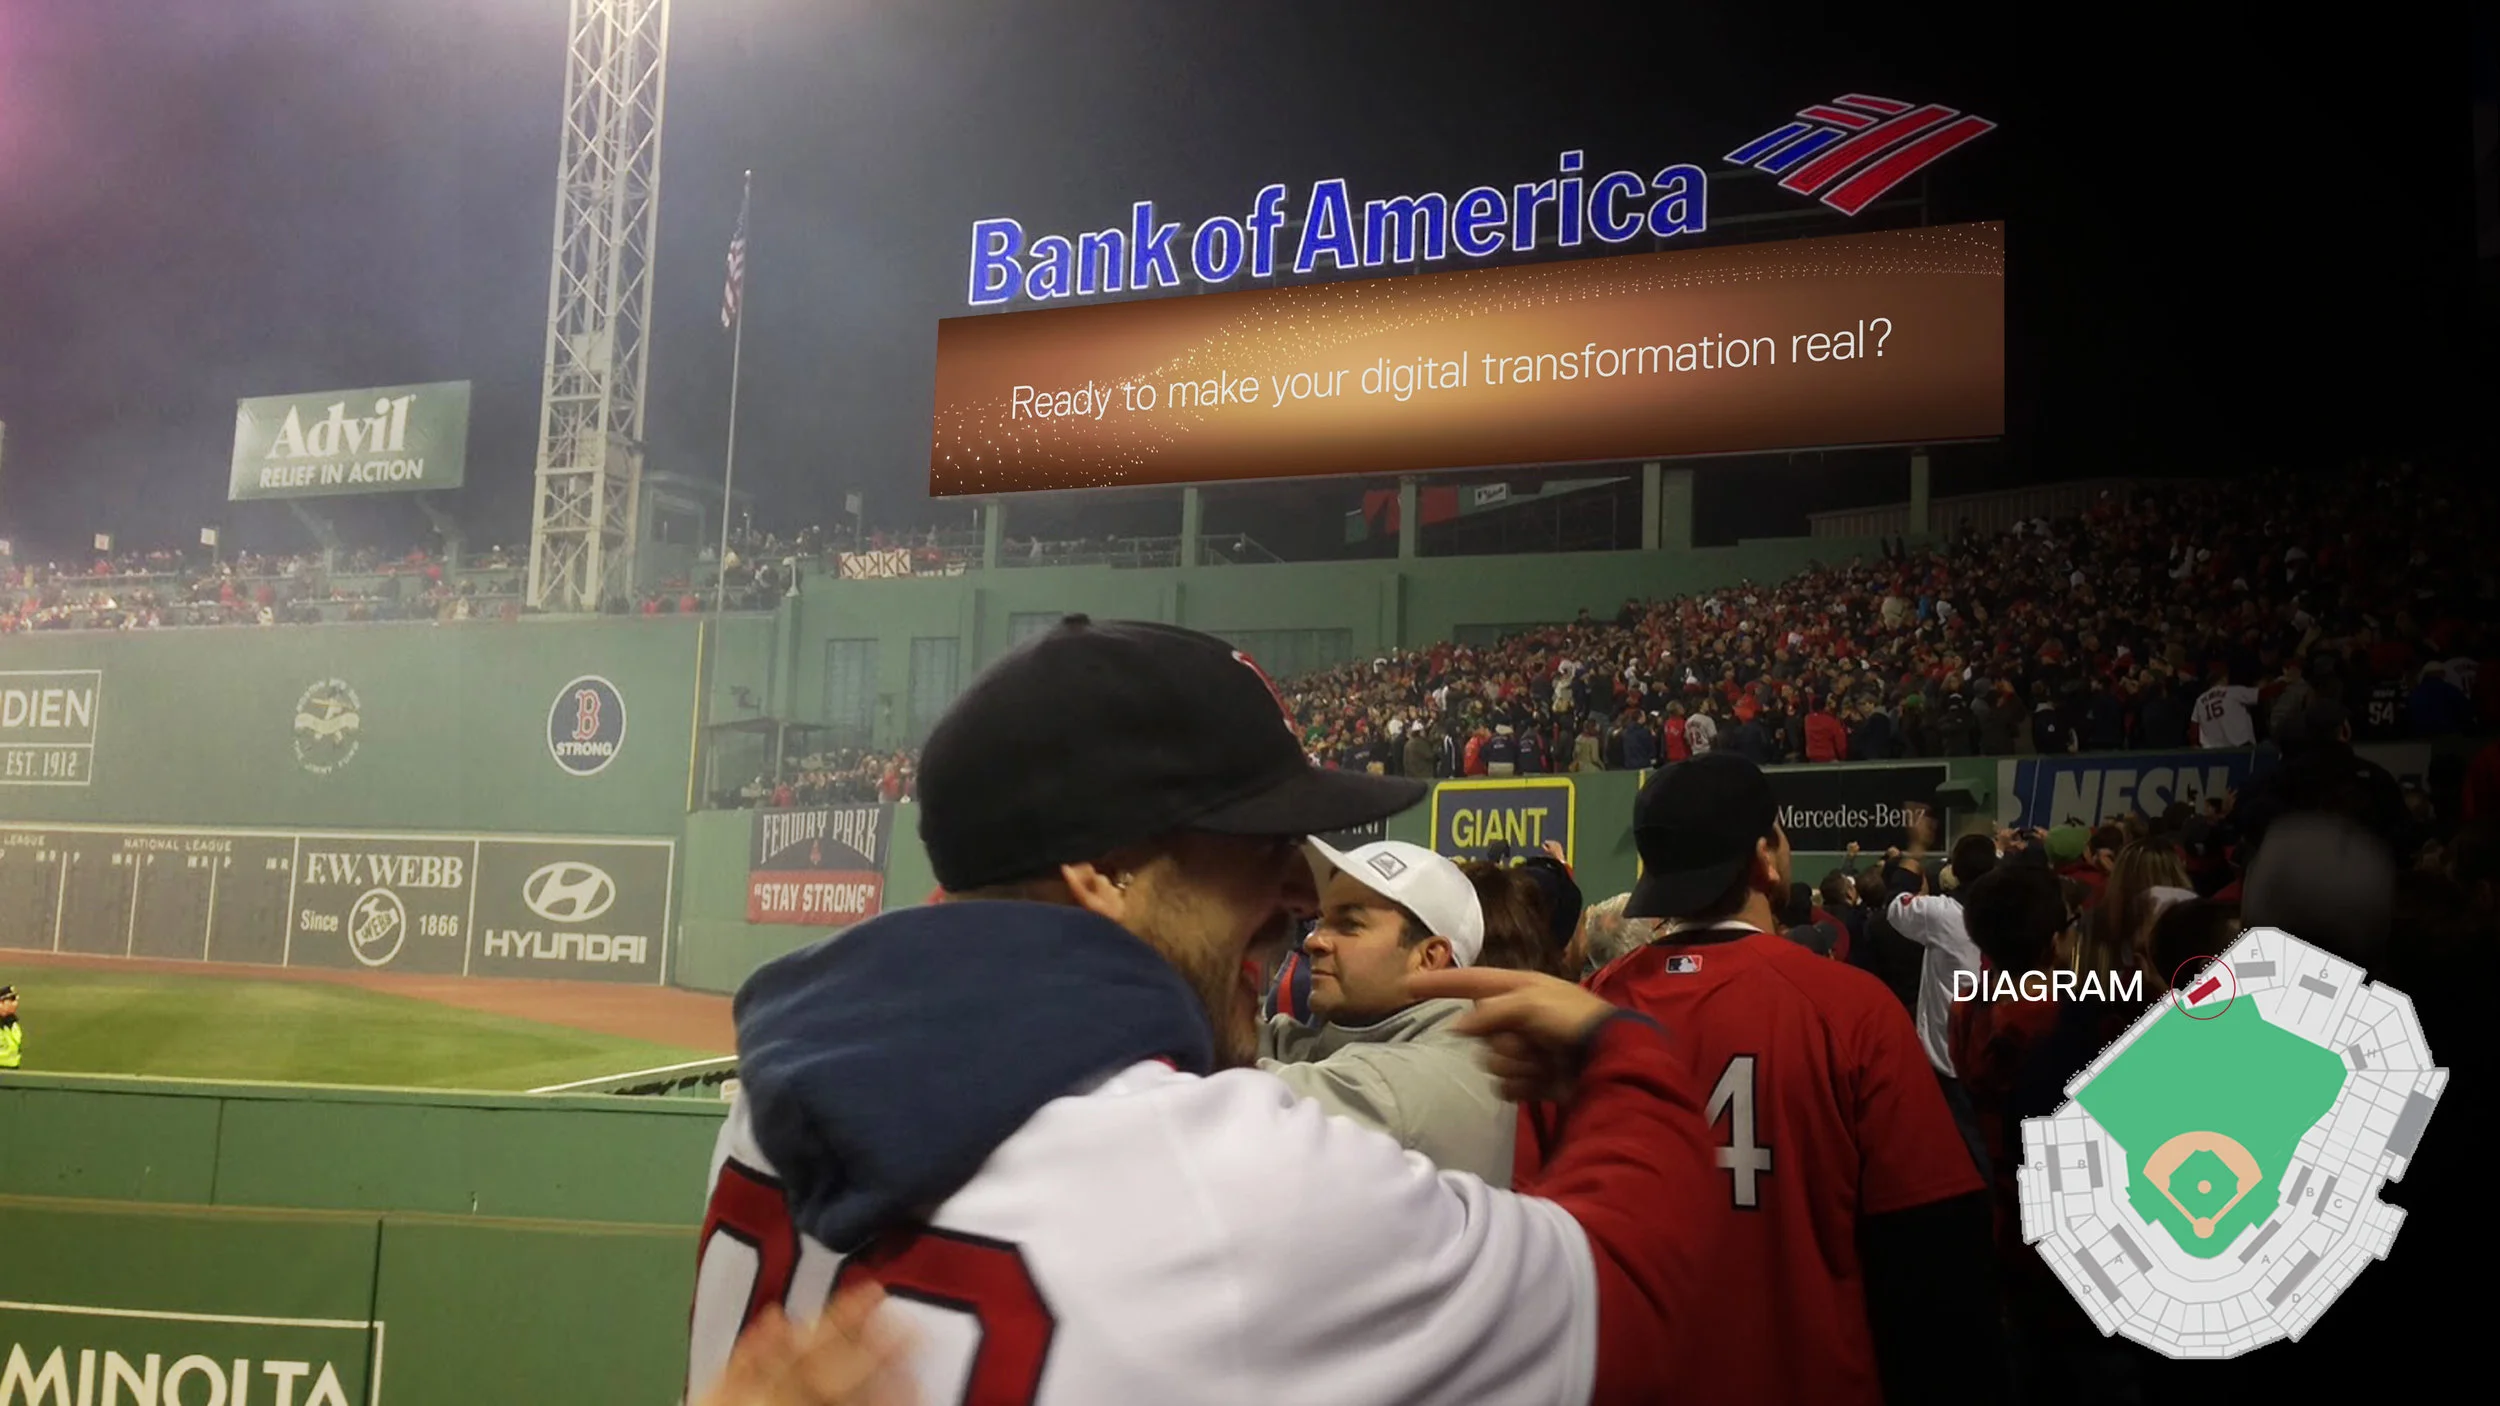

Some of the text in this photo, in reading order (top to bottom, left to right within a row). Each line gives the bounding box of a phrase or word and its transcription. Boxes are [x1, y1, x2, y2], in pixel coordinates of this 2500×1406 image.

[968, 148, 1708, 306] Bank of America
[1011, 317, 1893, 421] Ready to make your digital transformation real?
[264, 394, 411, 460] Advil
[259, 457, 424, 489] RELIEF IN ACTION
[0, 688, 92, 728] DIEN
[6, 750, 78, 778] EST. 1912
[555, 741, 613, 757] STRONG
[1451, 807, 1549, 848] GIANT
[1777, 803, 1926, 829] Mercedes-Benz
[123, 838, 233, 852] NATIONAL LEAGUE
[761, 808, 880, 865] FENWAY PARK
[304, 852, 463, 889] F.W. WEBB
[300, 909, 460, 938] Since 1866
[484, 929, 648, 965] HYUNDAI
[1703, 1055, 1772, 1207] 4
[0, 1341, 352, 1406] MINOLTA
